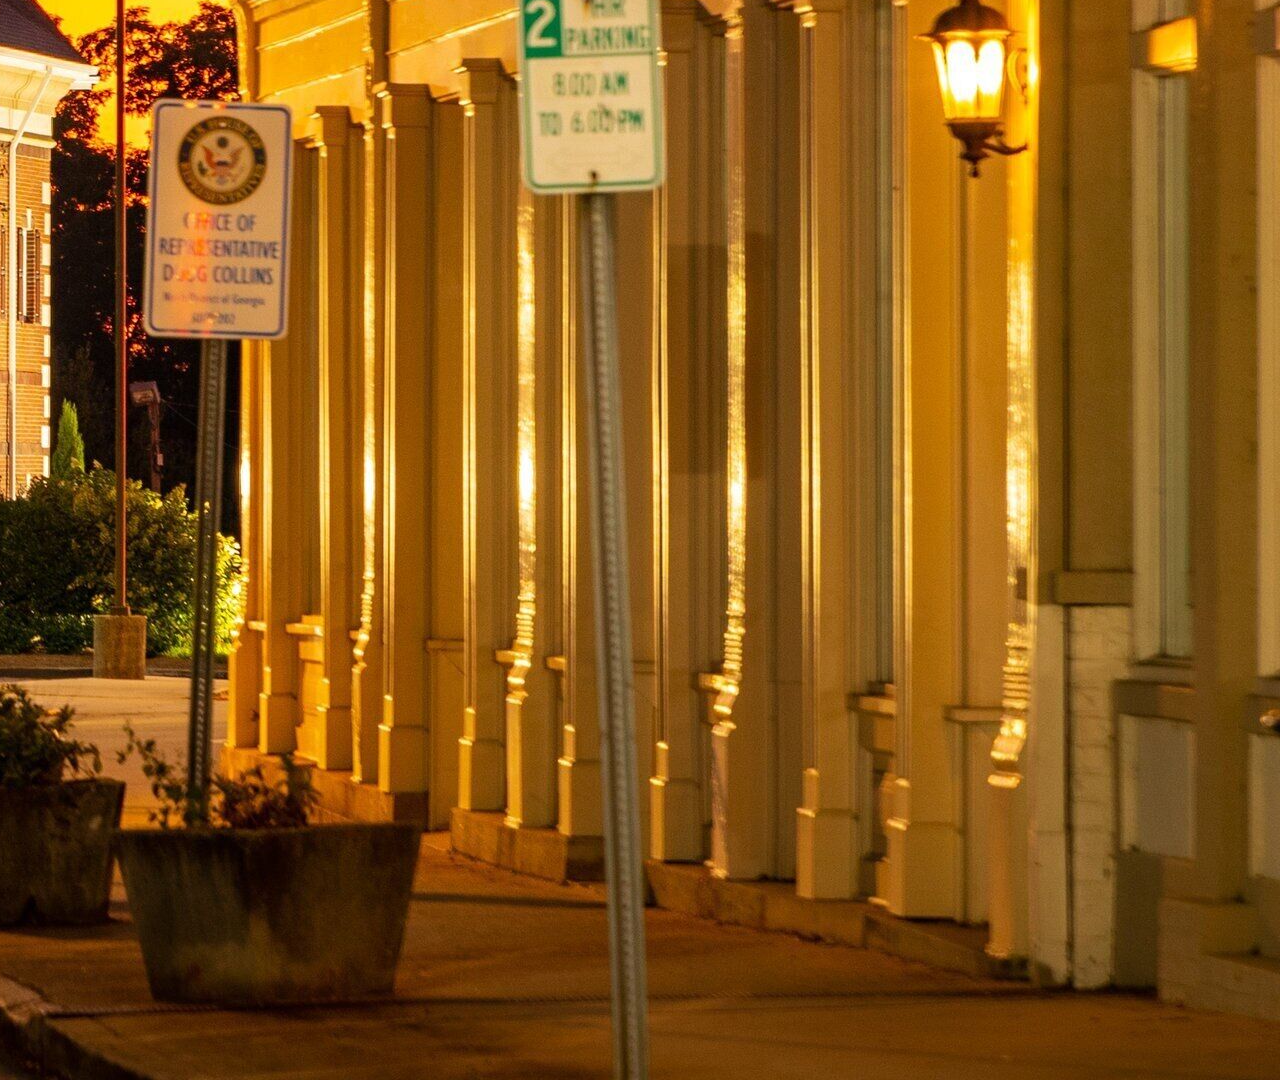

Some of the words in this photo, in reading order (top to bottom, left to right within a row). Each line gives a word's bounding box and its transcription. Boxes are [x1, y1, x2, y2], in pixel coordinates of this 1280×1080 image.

[565, 25, 649, 50] PARKING
[539, 111, 562, 136] TO
[237, 213, 256, 232] OF
[162, 263, 208, 283] DG
[214, 266, 273, 286] COLLINS
